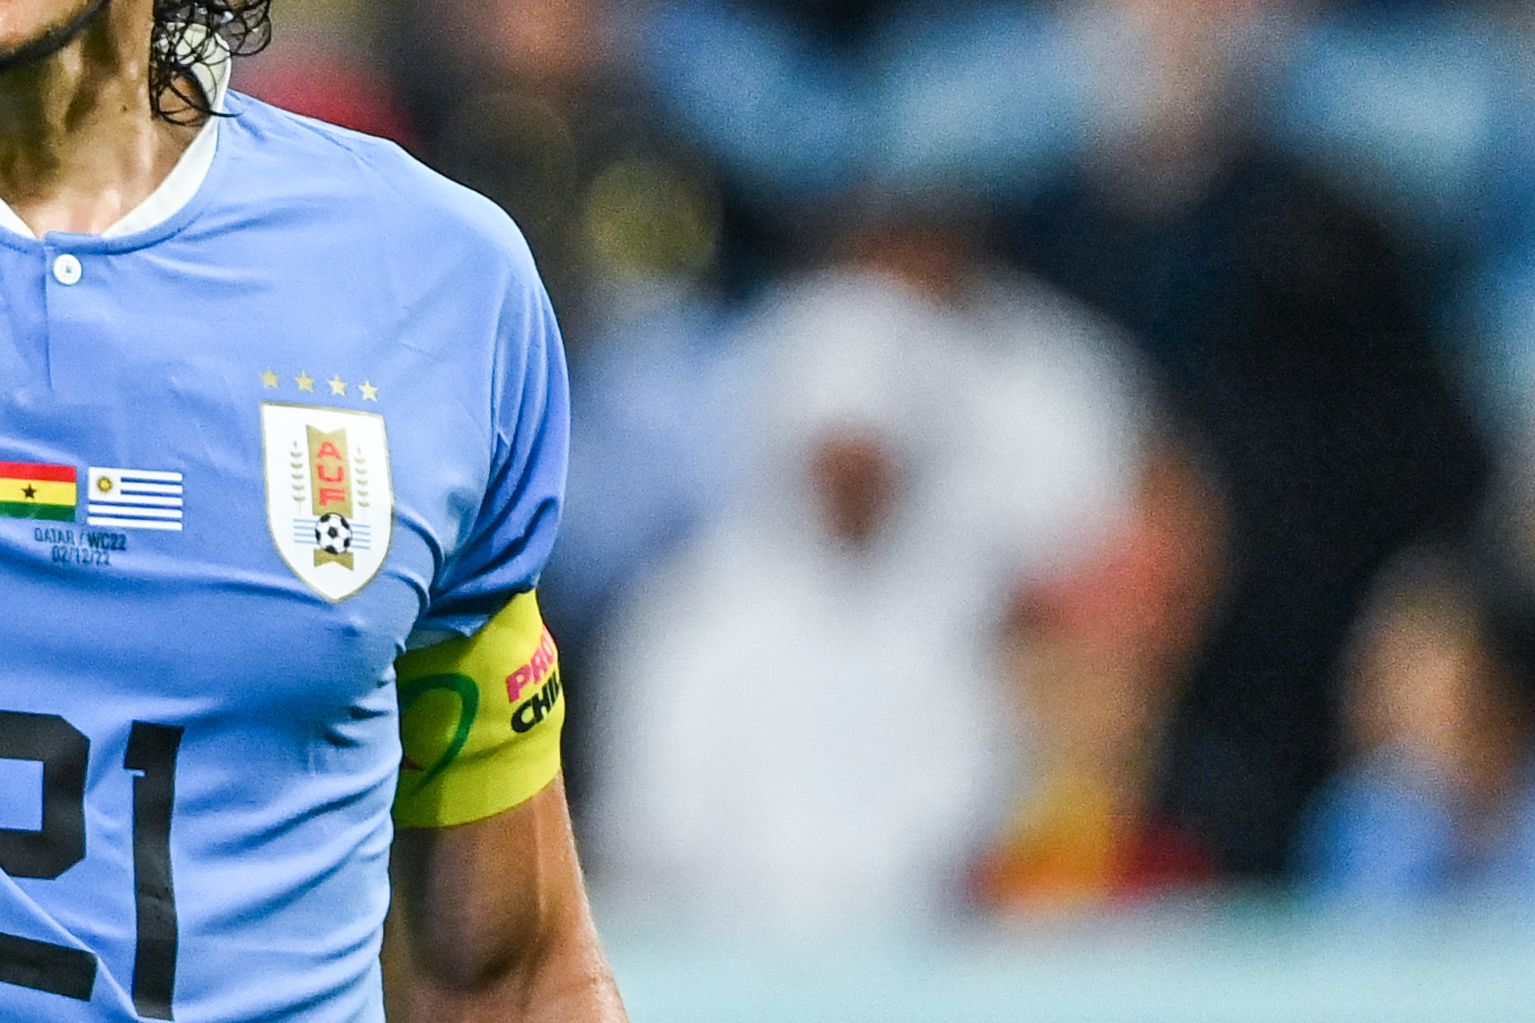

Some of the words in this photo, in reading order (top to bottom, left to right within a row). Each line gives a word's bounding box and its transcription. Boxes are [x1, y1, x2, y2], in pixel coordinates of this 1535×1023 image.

[317, 441, 346, 506] AUF
[34, 527, 75, 545] QATAR
[87, 531, 127, 551] WC22
